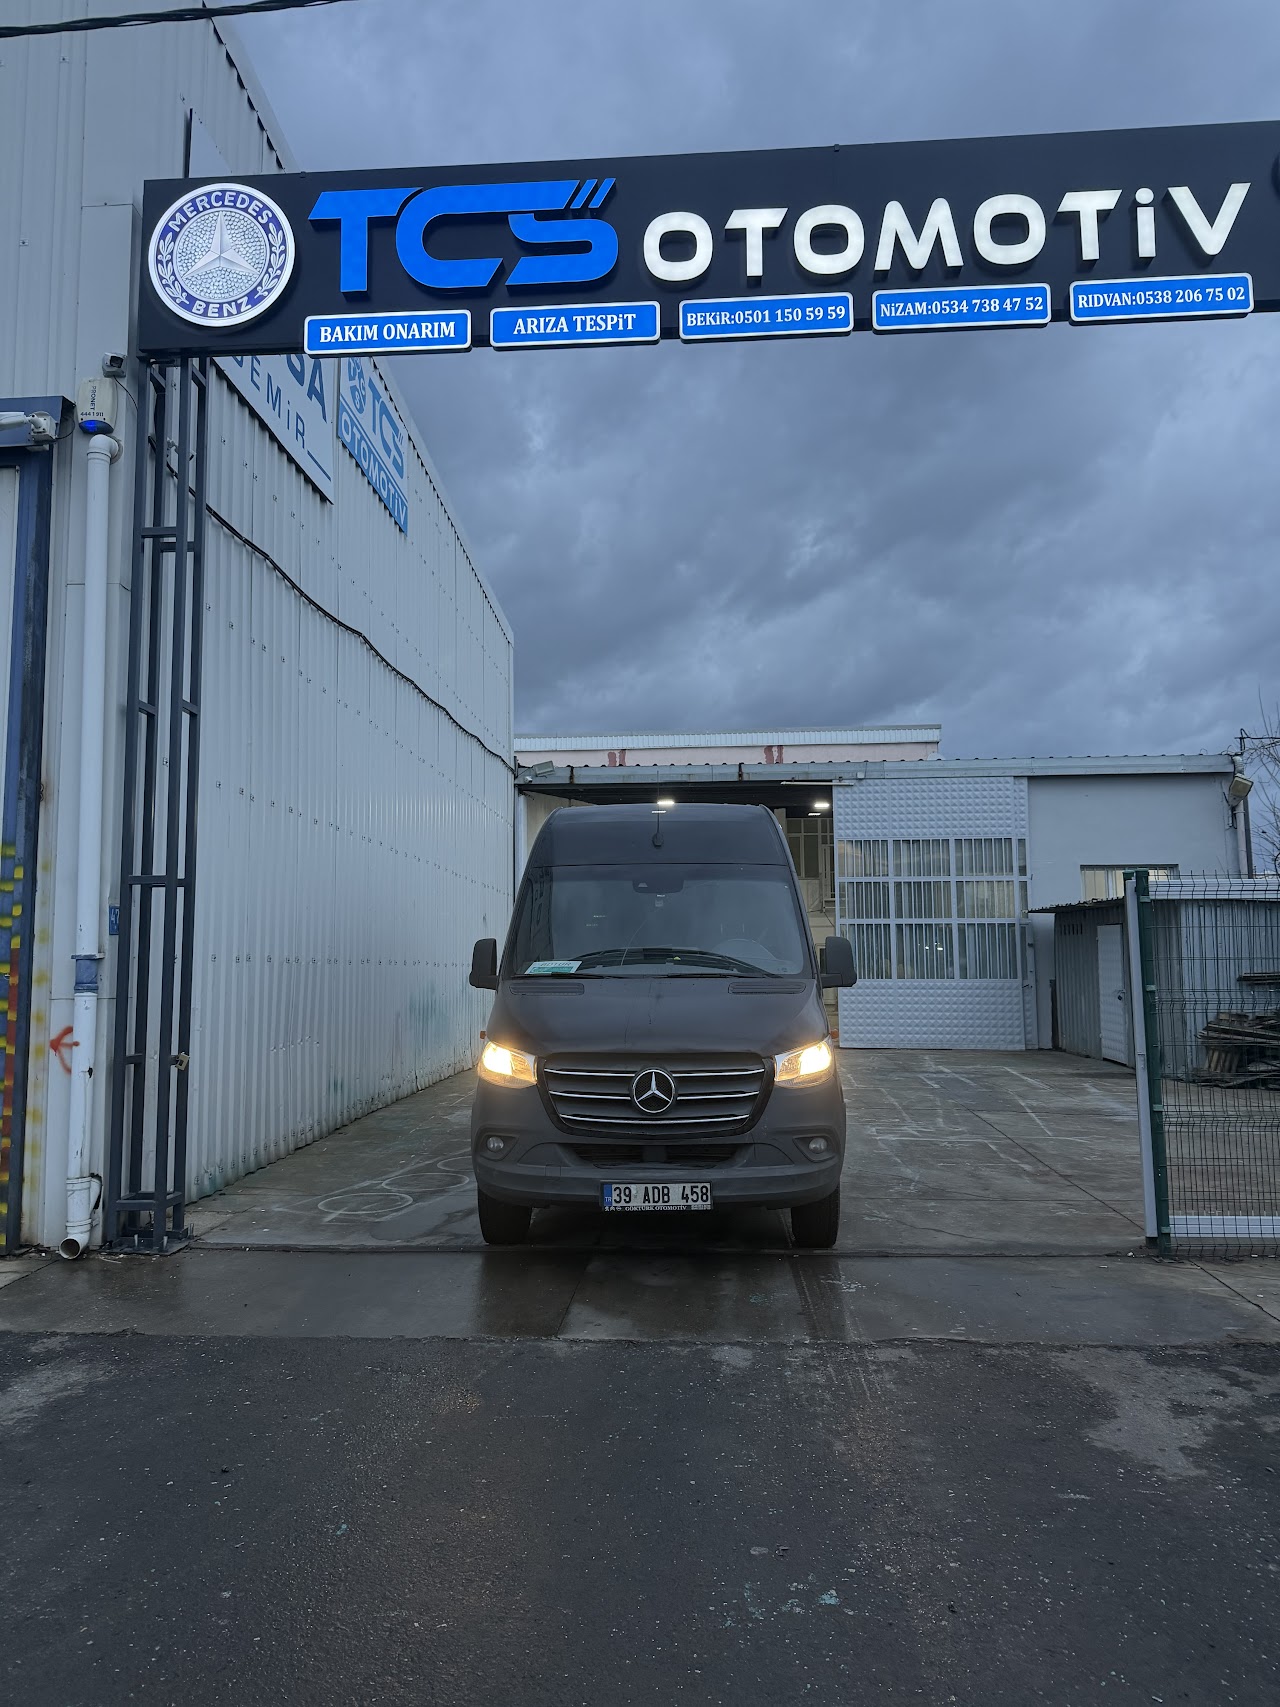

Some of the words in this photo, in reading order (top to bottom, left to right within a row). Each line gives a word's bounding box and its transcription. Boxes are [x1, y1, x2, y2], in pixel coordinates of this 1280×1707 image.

[168, 191, 272, 232] MERCEDES
[308, 178, 618, 292] TCS
[192, 296, 252, 318] BENZ
[972, 298, 1000, 313] 738
[1003, 297, 1022, 312] 47
[1025, 296, 1044, 311] 52
[1077, 290, 1173, 308] RIDVAN:0538
[1175, 289, 1203, 303] 206
[1205, 287, 1224, 301] 75
[1226, 286, 1245, 301] 02
[775, 308, 801, 323] 150
[806, 306, 824, 321] 59
[827, 305, 846, 320] 59
[319, 323, 381, 343] BAKIM
[383, 321, 456, 341] ONARIM
[513, 316, 569, 335] ARIZA
[613, 1186, 632, 1204] 39
[642, 1185, 671, 1204] ADB
[681, 1185, 709, 1203] 458
